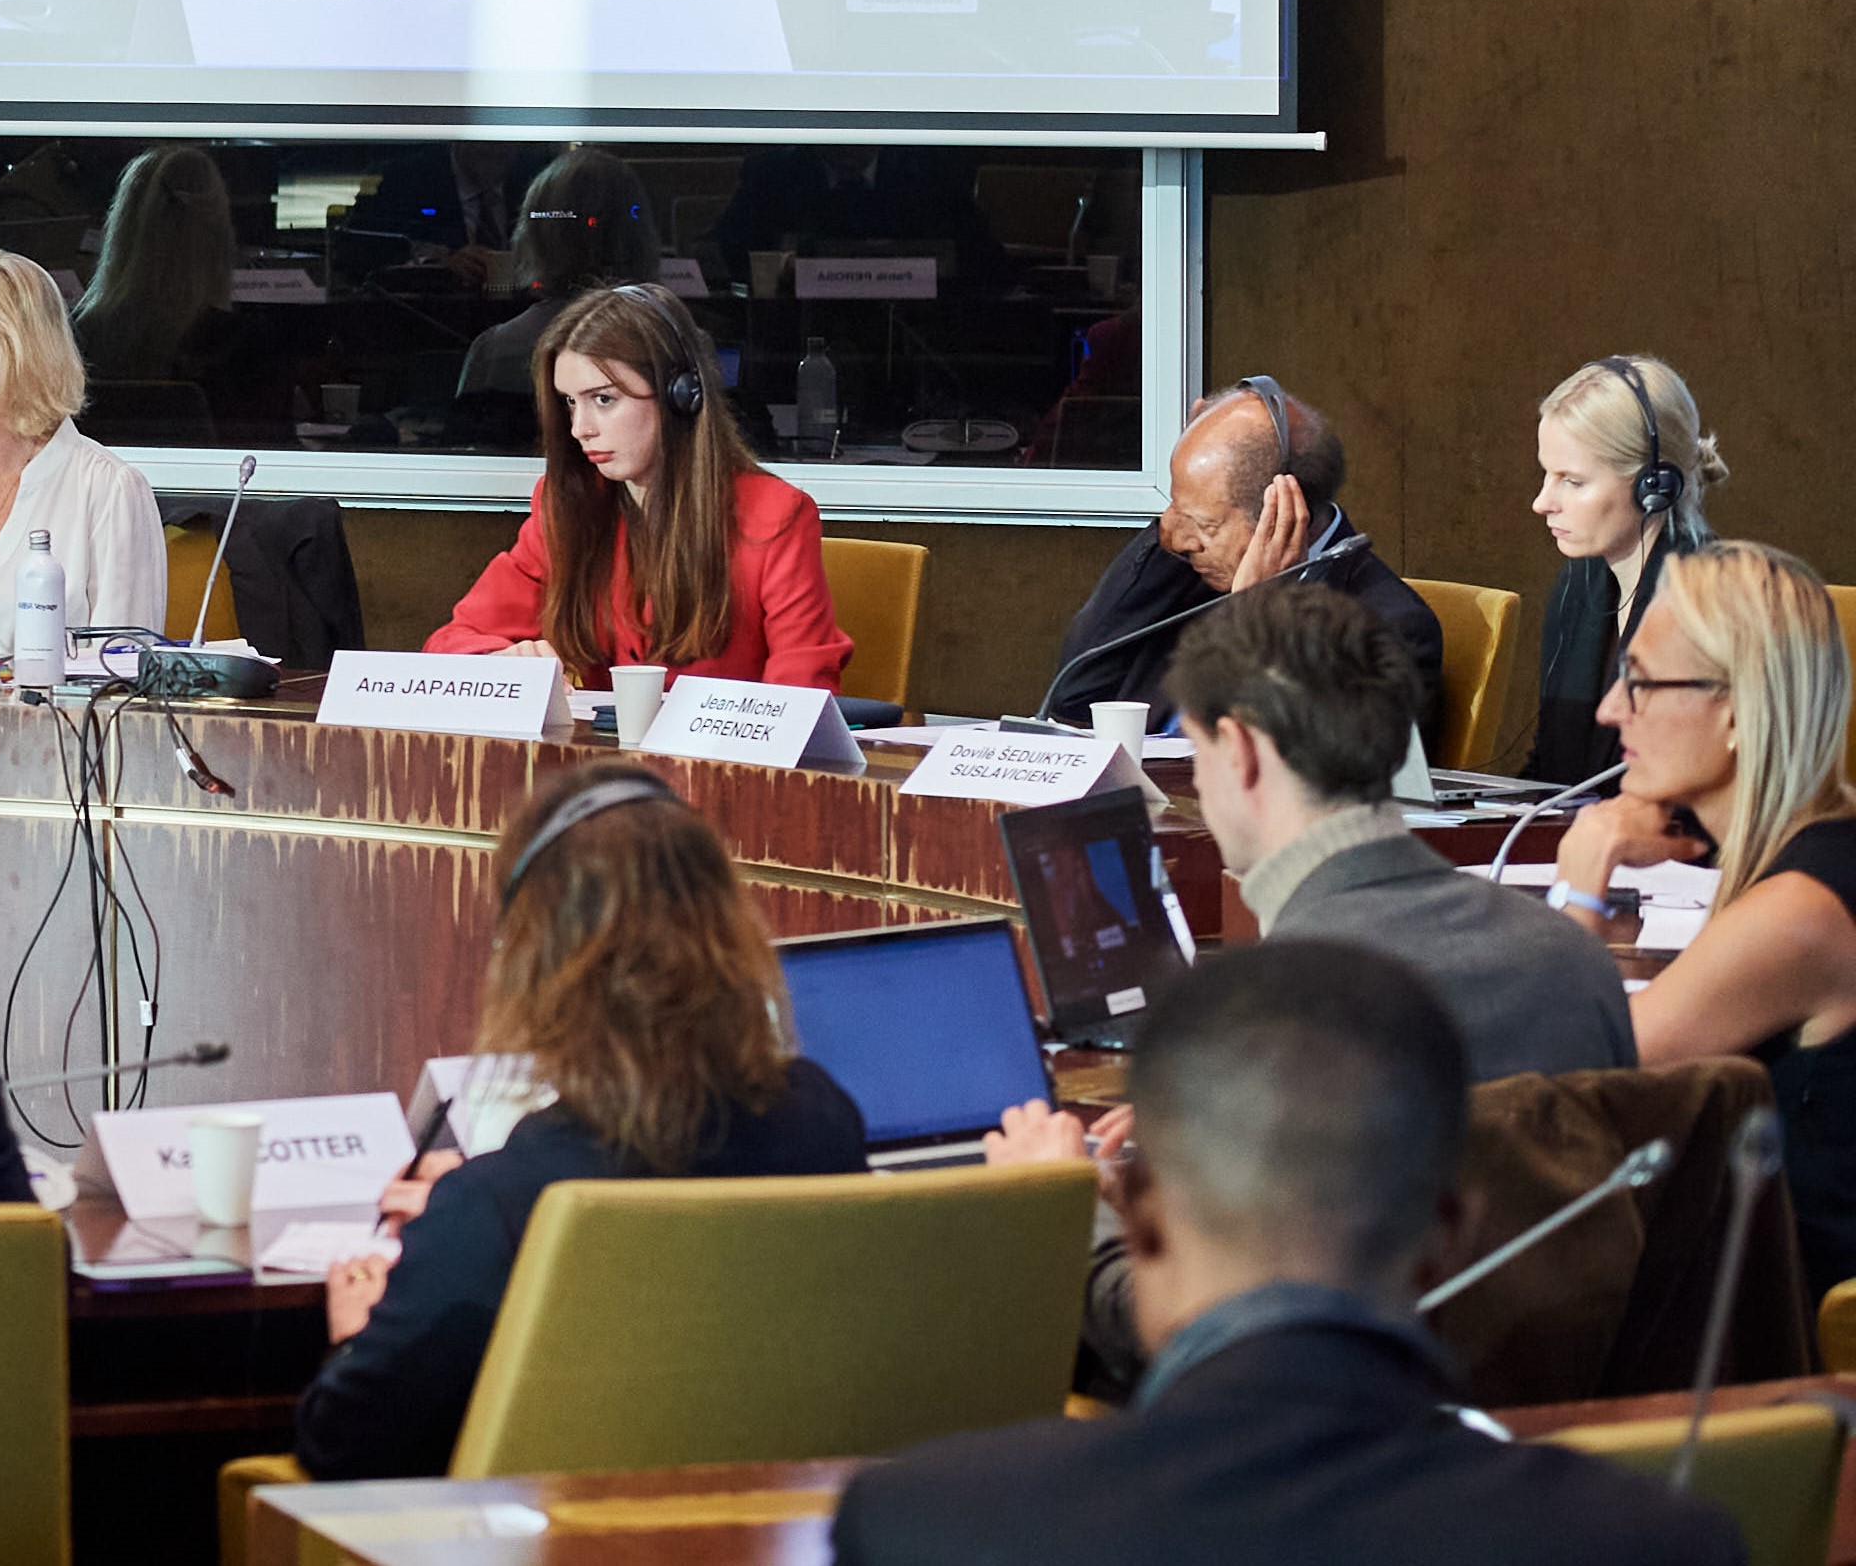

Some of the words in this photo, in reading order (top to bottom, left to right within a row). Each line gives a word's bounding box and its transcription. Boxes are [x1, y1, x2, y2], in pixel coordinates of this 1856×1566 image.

[356, 677, 395, 694] Ana
[401, 679, 523, 700] JAPARIDZE
[700, 693, 788, 718] Jean-Michel
[689, 717, 776, 742] OPRENDEK
